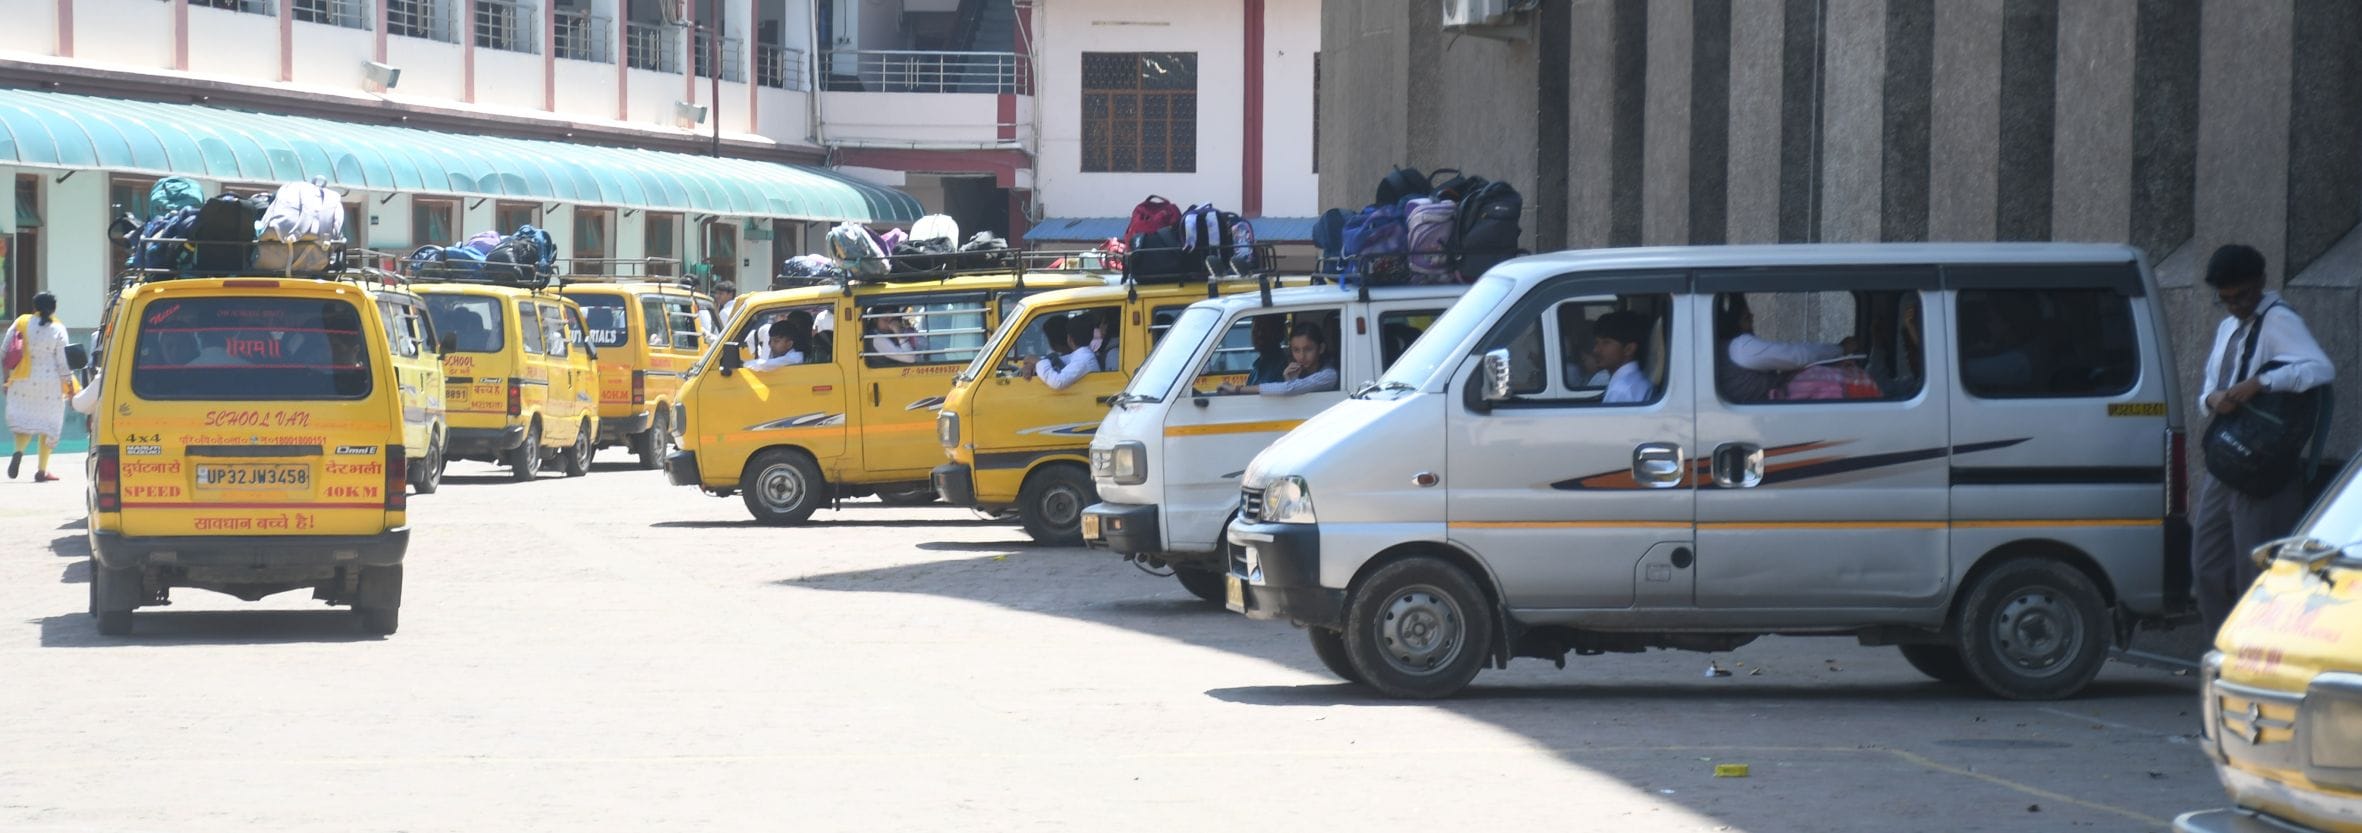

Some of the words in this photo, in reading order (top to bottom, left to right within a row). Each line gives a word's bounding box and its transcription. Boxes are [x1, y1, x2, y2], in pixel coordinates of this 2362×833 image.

[570, 329, 617, 343] UTRIALS
[204, 410, 270, 427] SCHOOL
[275, 411, 310, 427] VAN
[207, 469, 306, 484] UP32JW3458
[124, 486, 181, 497] SPEED
